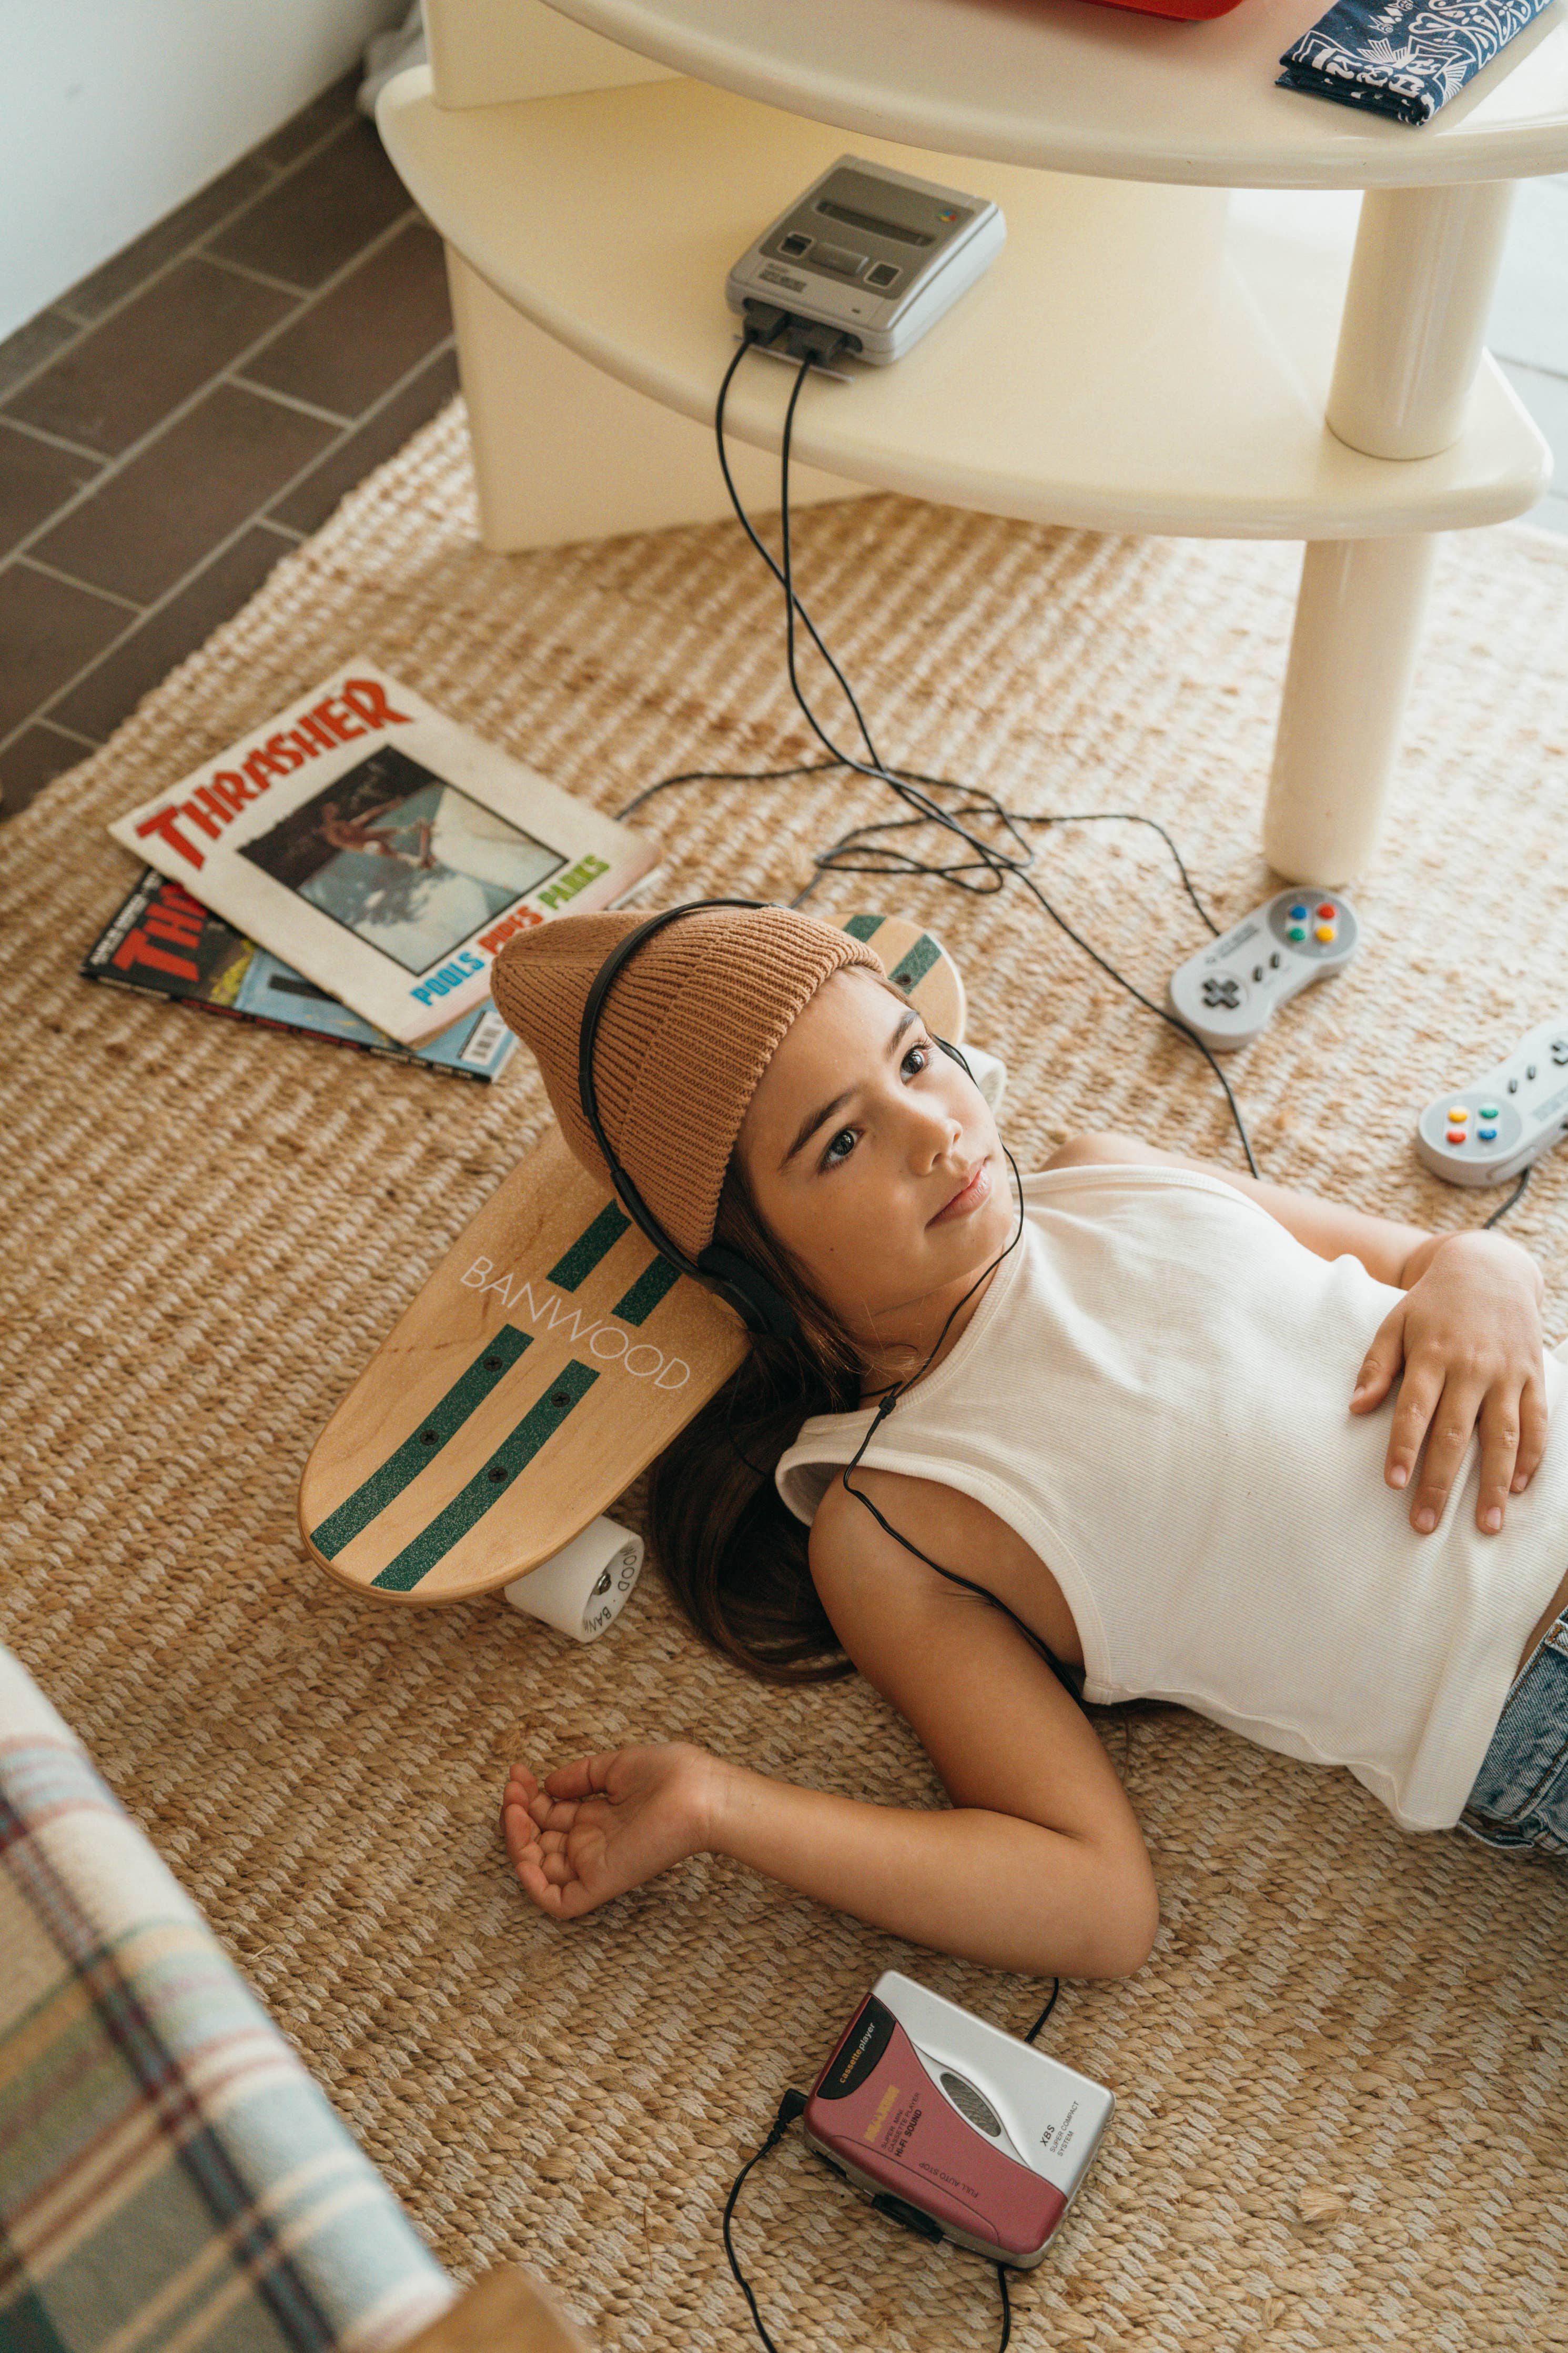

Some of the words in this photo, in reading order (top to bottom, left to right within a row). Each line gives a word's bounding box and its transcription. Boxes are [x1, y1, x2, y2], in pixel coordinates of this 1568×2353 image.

[135, 678, 414, 871] THRASHER
[410, 951, 484, 1006] POOLS
[477, 906, 543, 955] PIPES
[537, 853, 610, 910] PARKS
[460, 1255, 690, 1390] BANWOOD
[881, 2126, 895, 2149] SUPER
[894, 2109, 903, 2124] MINI
[888, 2118, 907, 2152] CASSETTE
[905, 2092, 920, 2117] PLAYER
[895, 2138, 908, 2157] HI-FI
[905, 2109, 922, 2137] SOUND
[1040, 2125, 1055, 2147] XBS
[1049, 2131, 1064, 2153] SUPER
[1061, 2100, 1079, 2131] COMPACT
[1057, 2130, 1074, 2157] SYSTEM
[919, 2163, 939, 2176] STOP
[939, 2172, 960, 2186] AUTO
[962, 2183, 978, 2198] FULL
